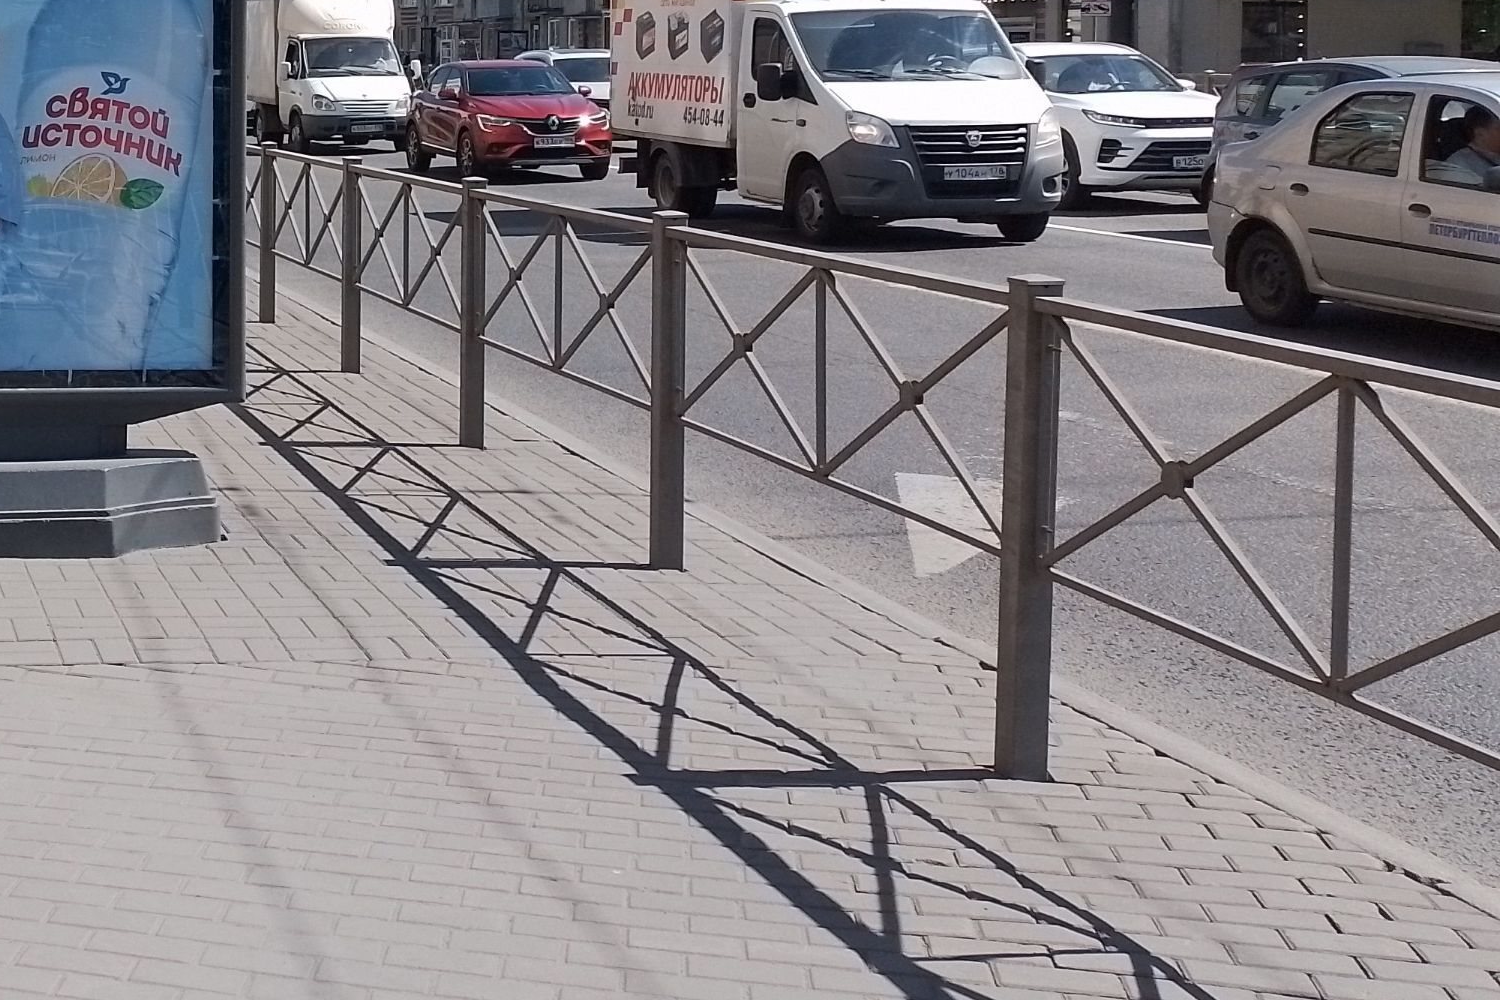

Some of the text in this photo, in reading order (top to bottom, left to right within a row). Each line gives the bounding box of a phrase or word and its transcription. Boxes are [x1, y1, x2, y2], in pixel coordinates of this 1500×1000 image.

[628, 72, 725, 104] АККУМУЛЯТОРЫ
[46, 87, 170, 139] СВЯТОЙ
[628, 99, 654, 119] katod.ru
[683, 106, 725, 127] 454-08-44
[22, 123, 183, 177] ИСТОЧНИК
